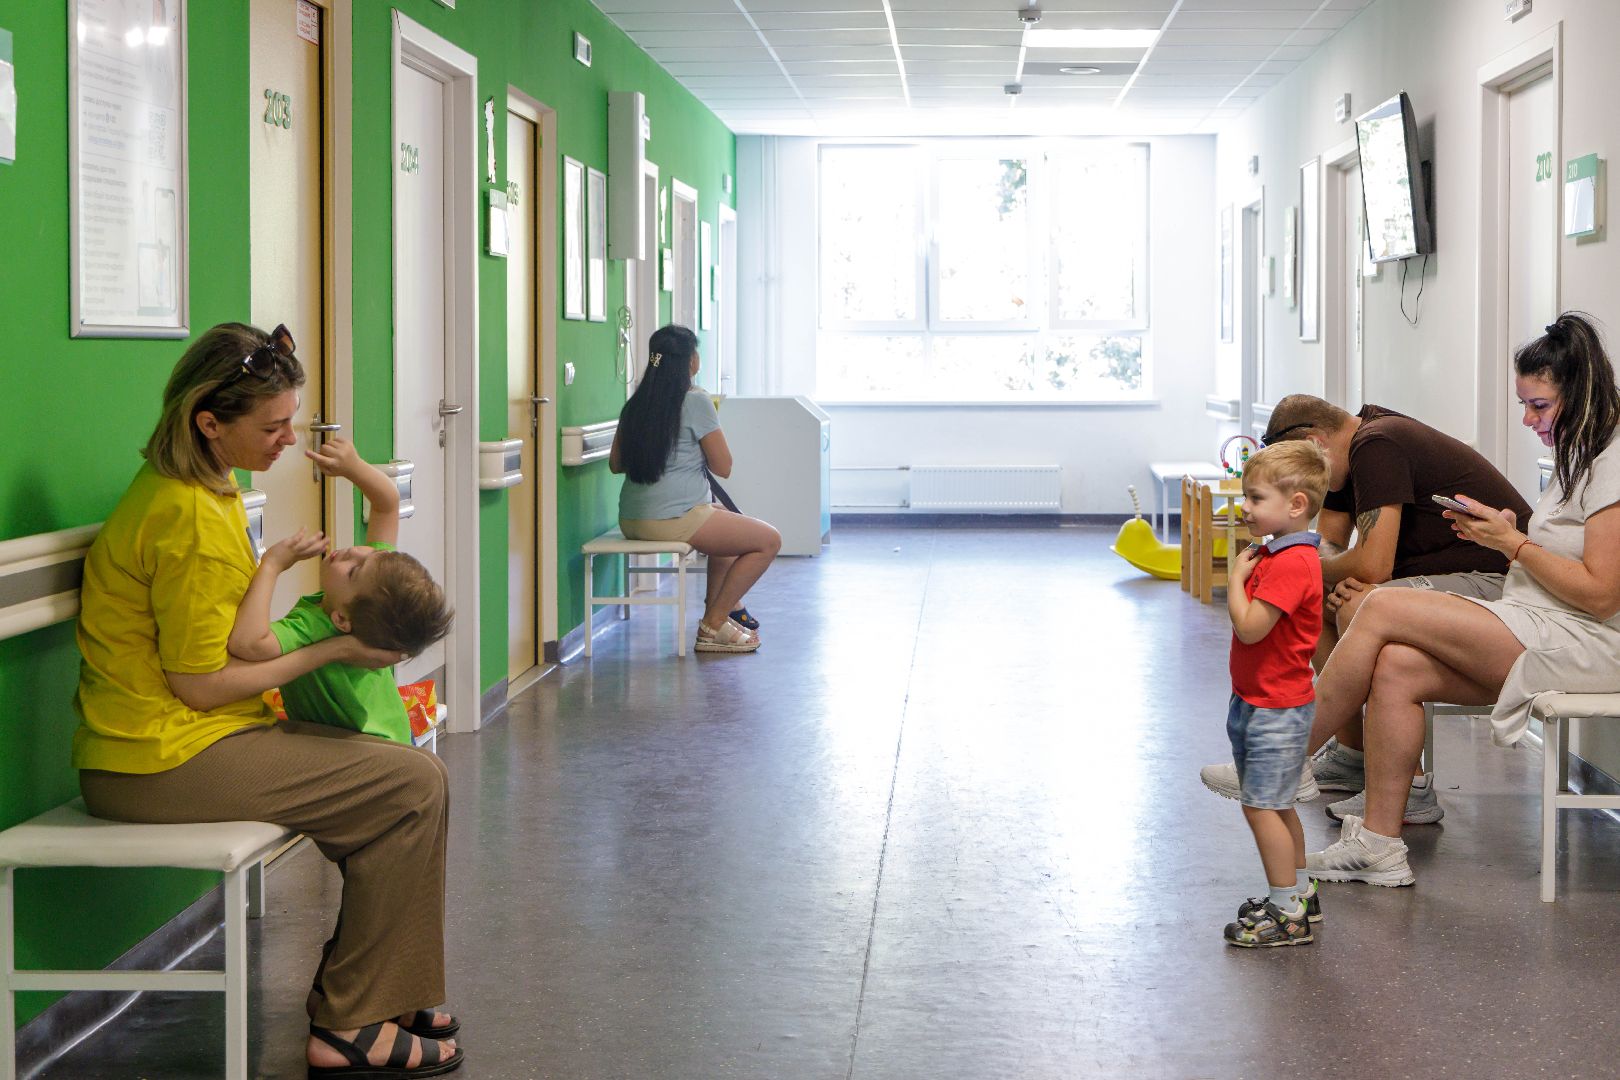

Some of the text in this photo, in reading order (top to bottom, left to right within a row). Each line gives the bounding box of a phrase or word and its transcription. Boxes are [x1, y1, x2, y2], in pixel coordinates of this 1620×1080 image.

[264, 88, 291, 129] 203
[401, 142, 418, 175] 204
[1536, 152, 1553, 182] 210
[1568, 163, 1578, 179] 210
